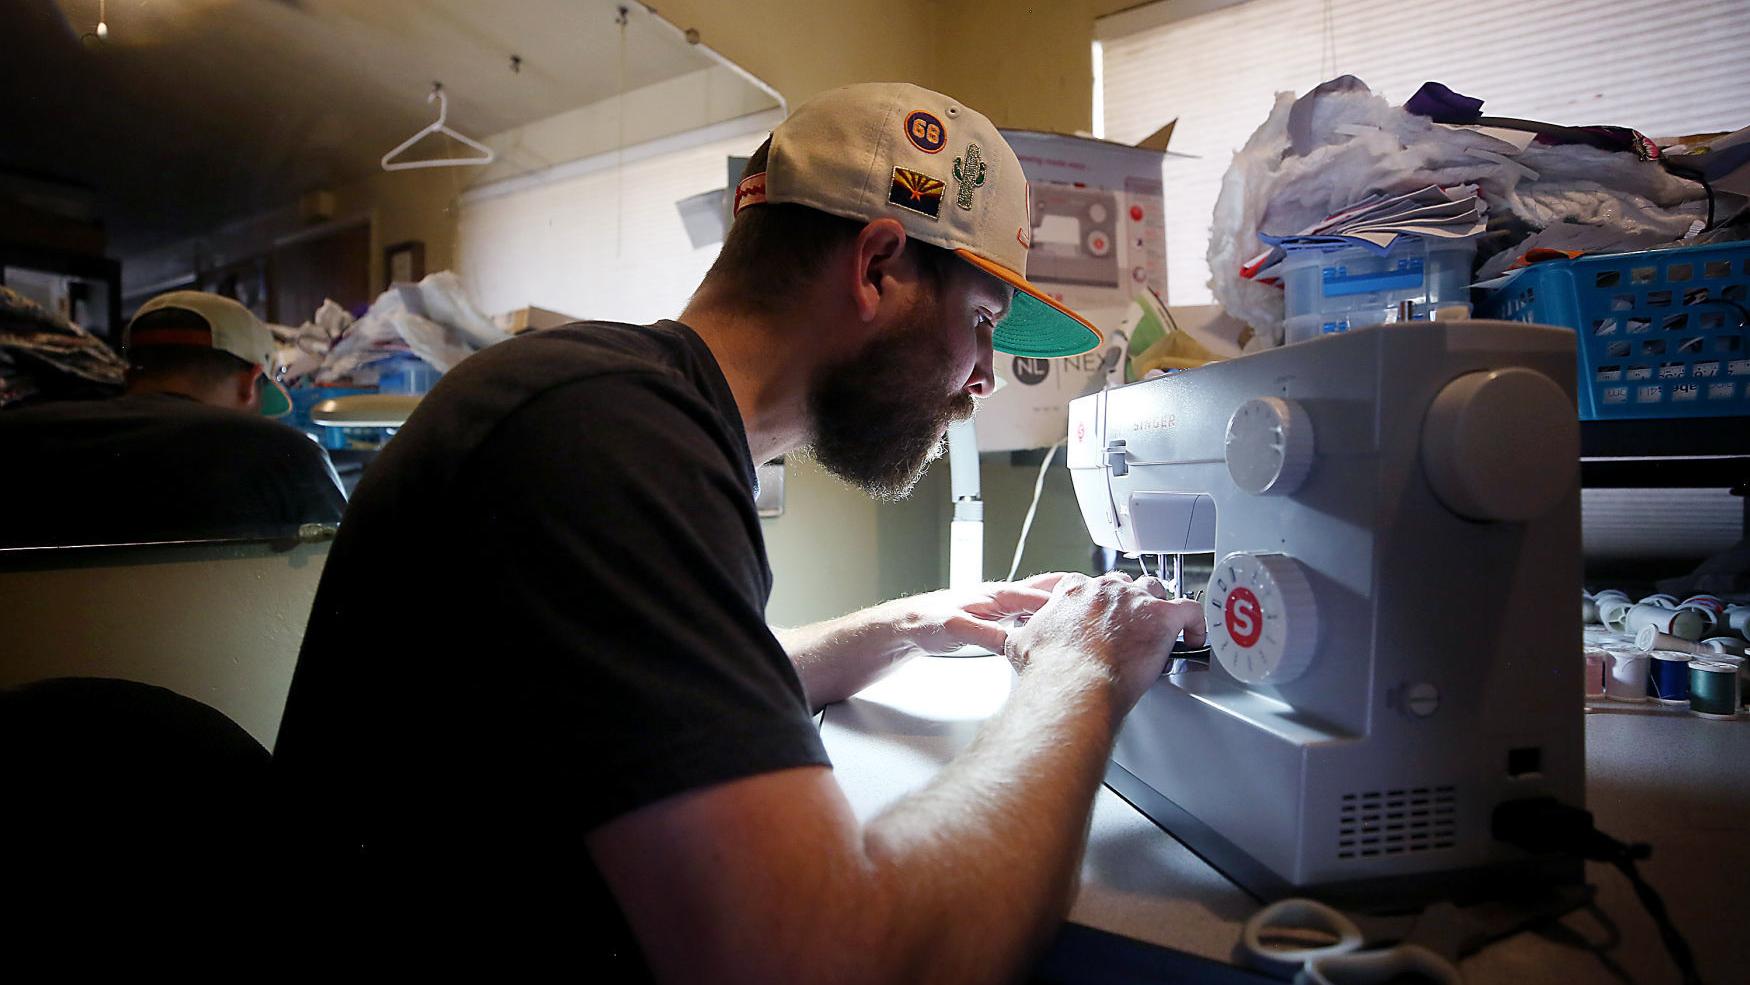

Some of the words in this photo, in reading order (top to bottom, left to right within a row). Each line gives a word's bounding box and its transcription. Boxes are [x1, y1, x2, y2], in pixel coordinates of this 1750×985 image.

[912, 118, 941, 144] 68
[1017, 358, 1045, 376] NL
[1132, 414, 1176, 432] SINGER
[1233, 599, 1254, 637] S
